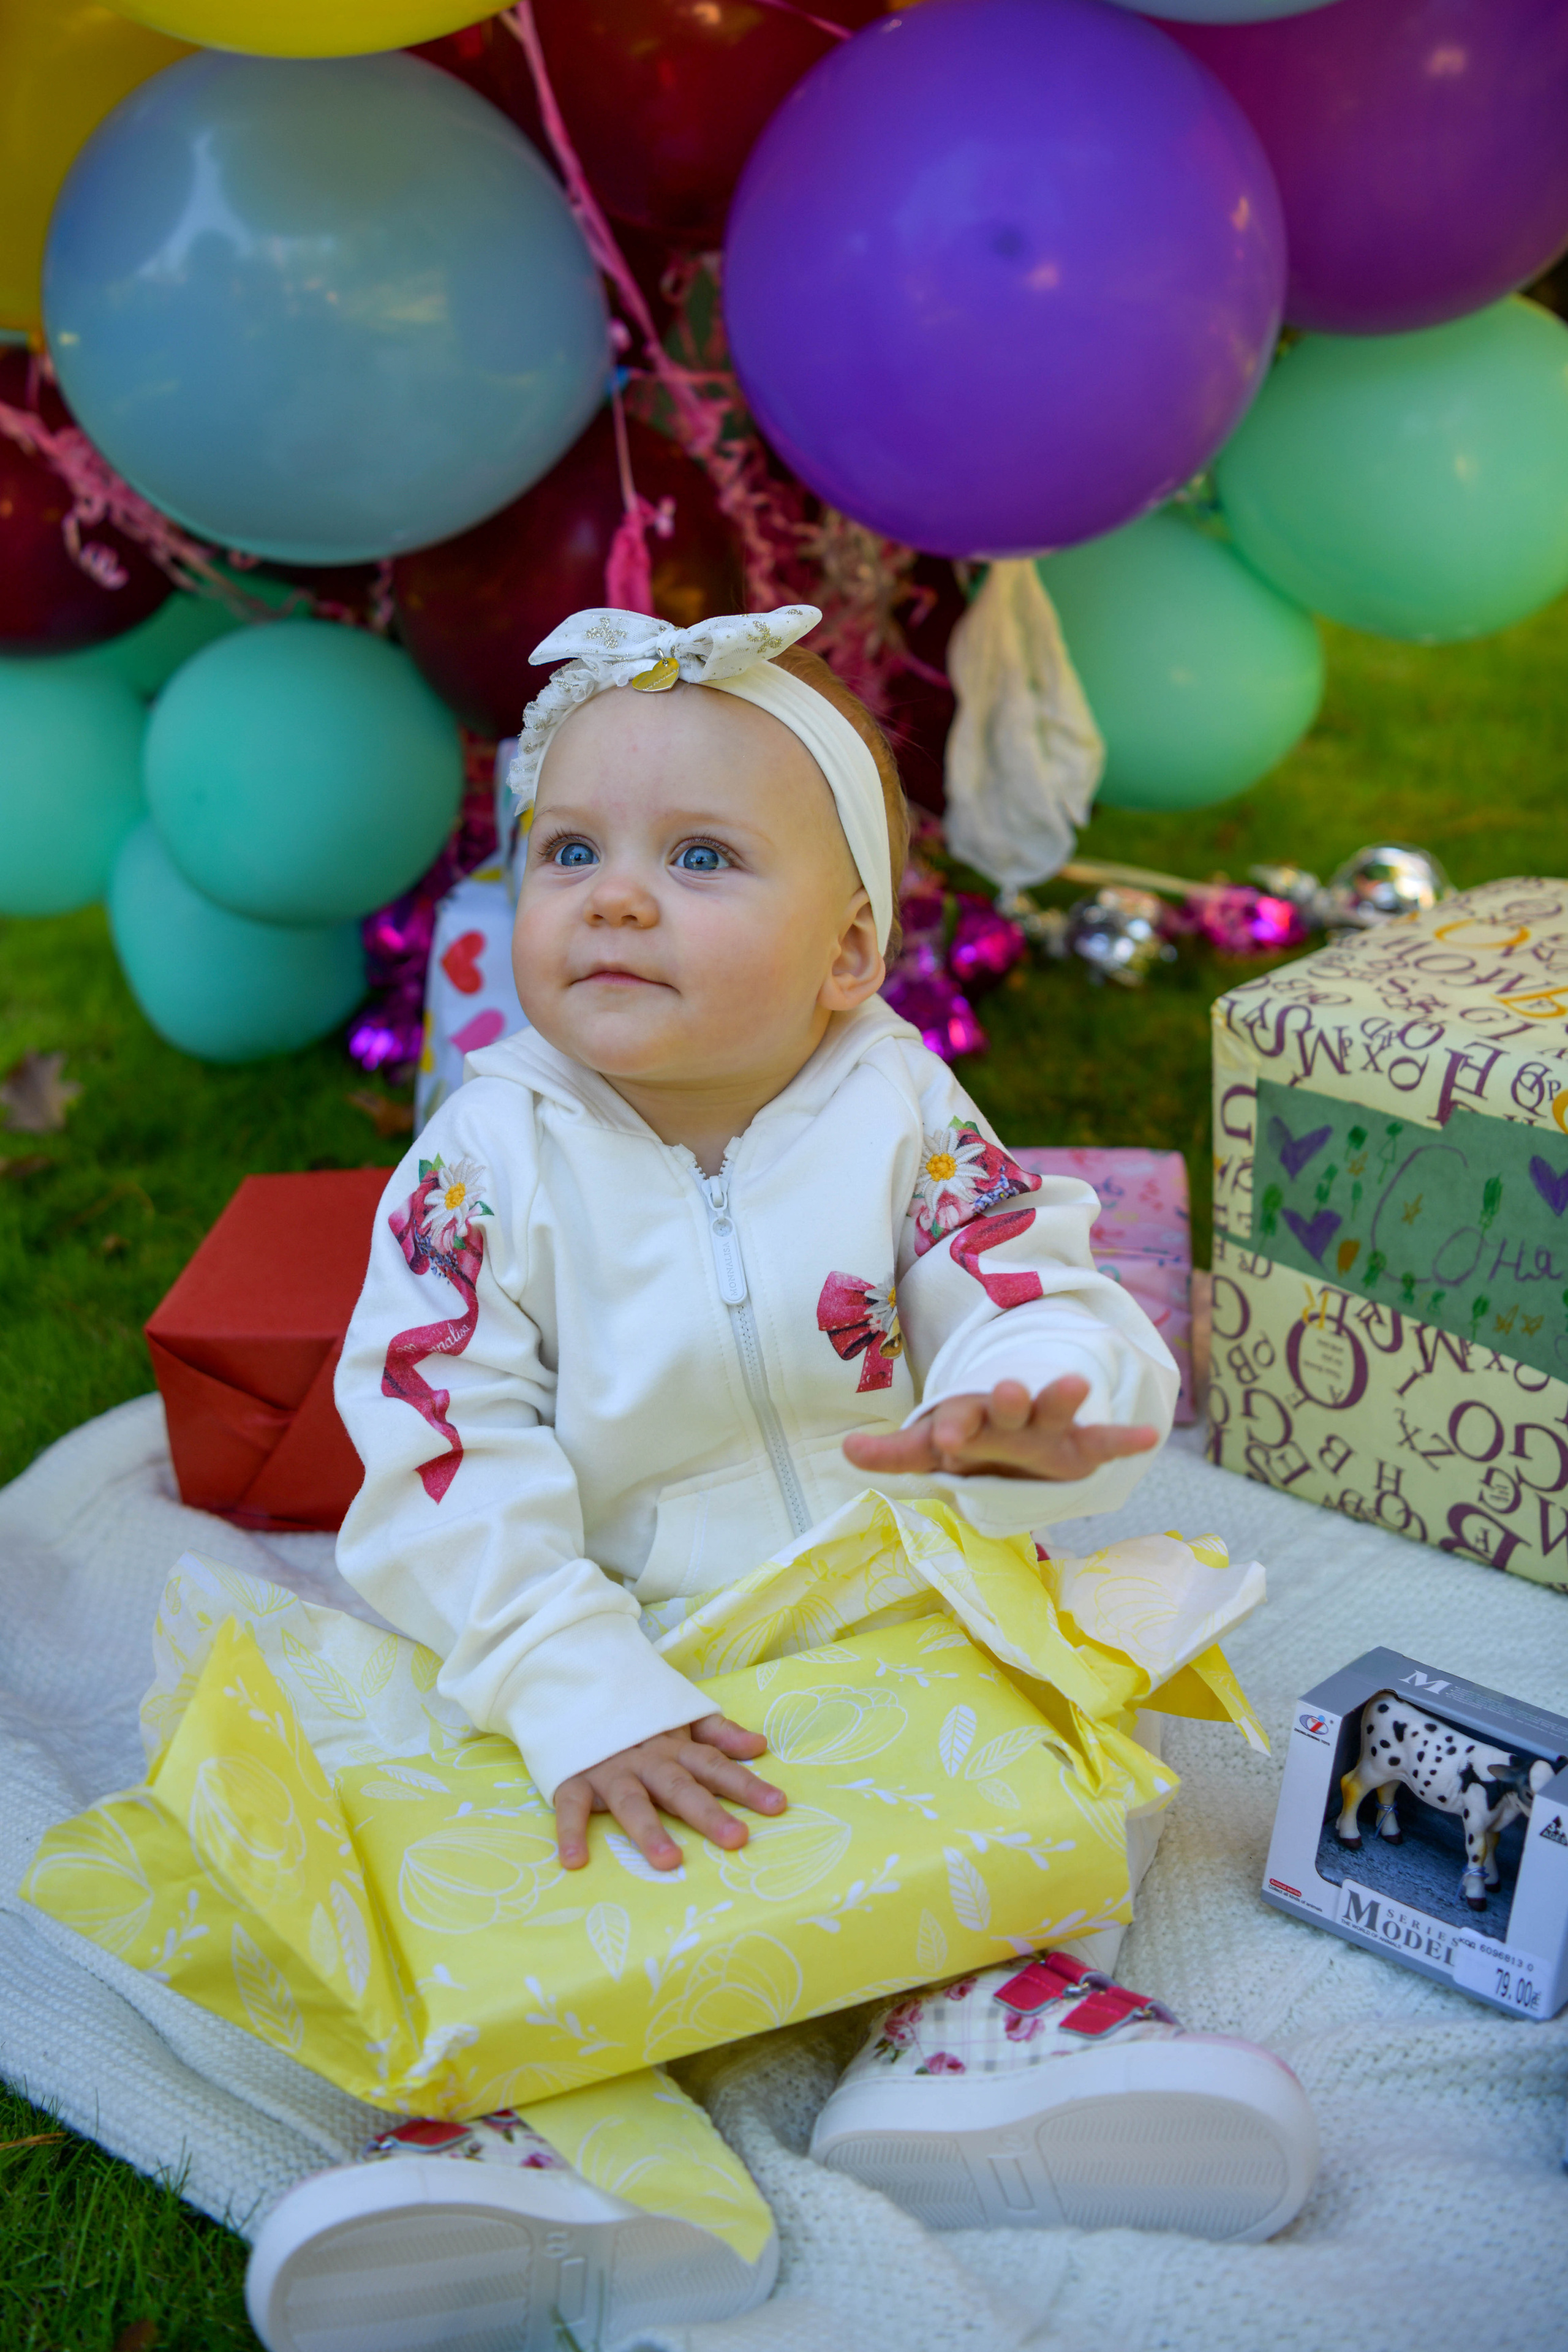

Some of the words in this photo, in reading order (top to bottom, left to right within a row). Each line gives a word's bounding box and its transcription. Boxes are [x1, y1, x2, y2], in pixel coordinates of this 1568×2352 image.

[722, 1241, 739, 1297] MONNALISA
[1268, 1884, 1283, 1894] Collect
[1289, 1893, 1300, 1902] kinds
[1306, 1902, 1323, 1912] animals
[1270, 1879, 1287, 1890] Animal
[1287, 1887, 1302, 1896] series
[1341, 1918, 1352, 1927] THE
[1352, 1923, 1371, 1936] WORLD
[1379, 1936, 1402, 1950] ANIMALS
[1386, 1909, 1459, 1948] SERIES
[1479, 1943, 1523, 1968] 6096813
[1496, 1967, 1533, 2007] 79.00
